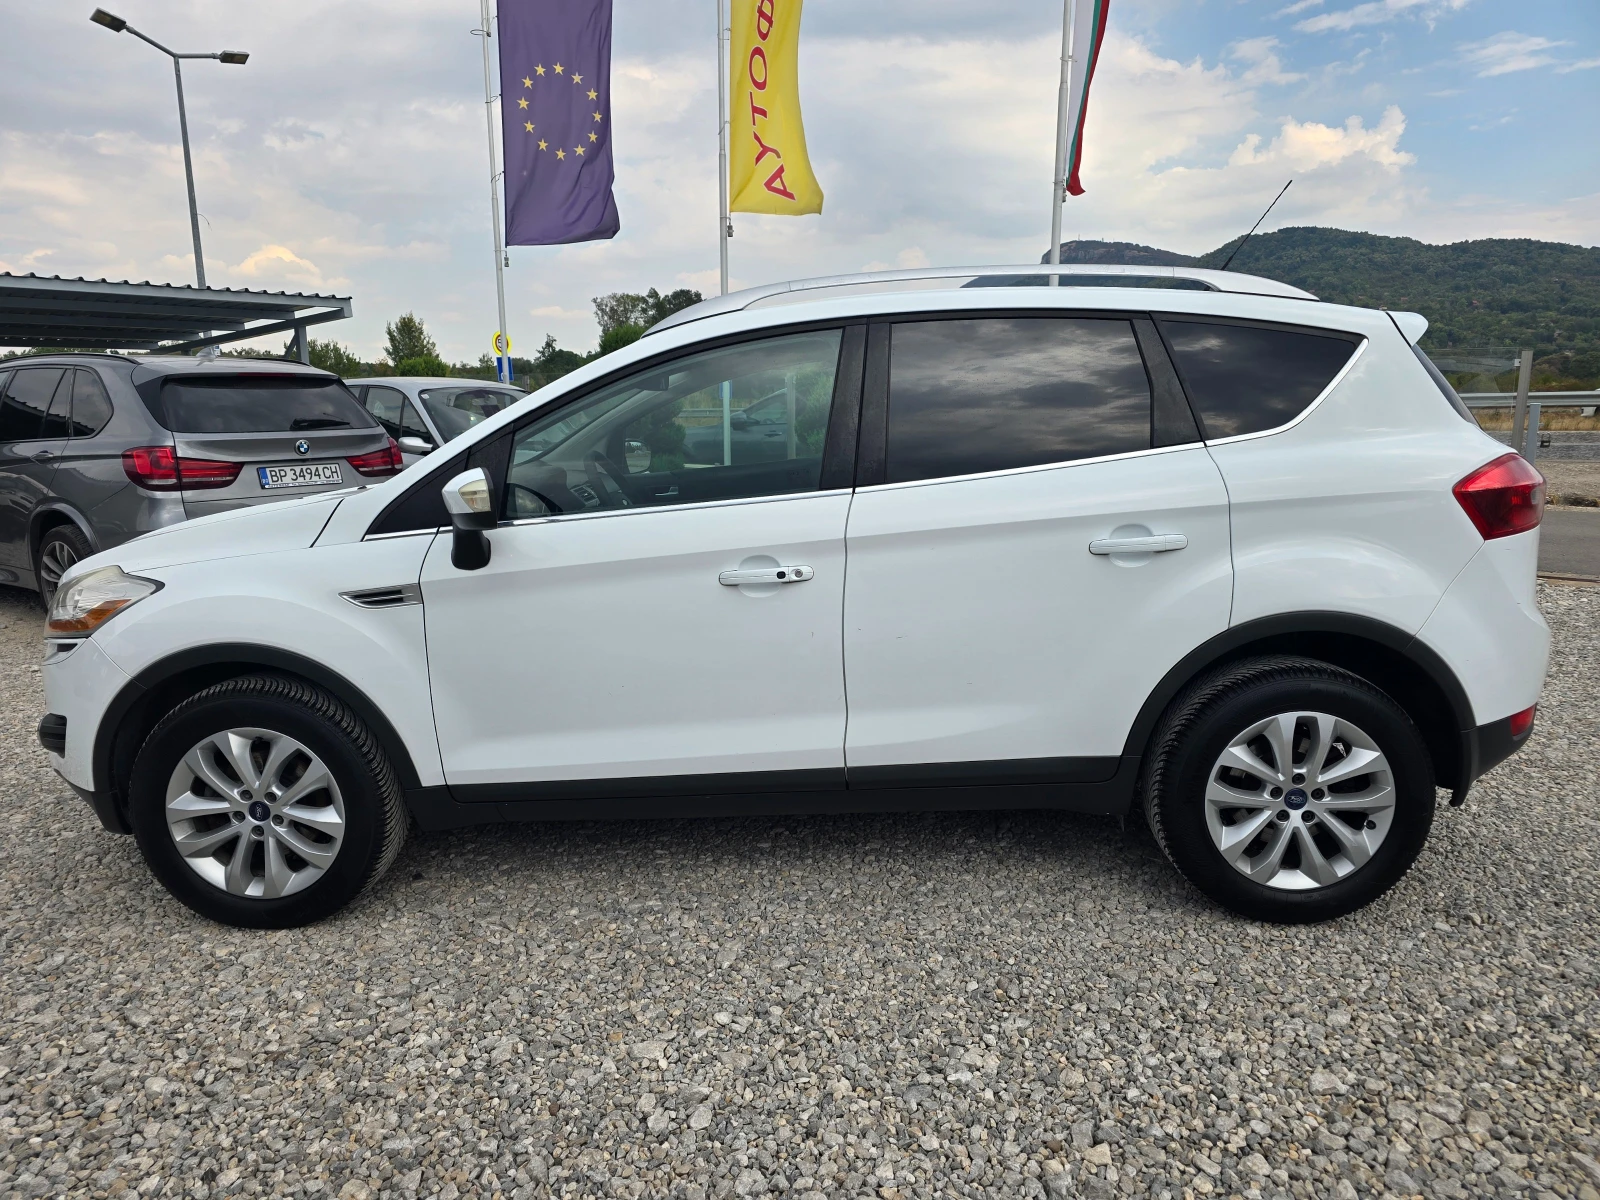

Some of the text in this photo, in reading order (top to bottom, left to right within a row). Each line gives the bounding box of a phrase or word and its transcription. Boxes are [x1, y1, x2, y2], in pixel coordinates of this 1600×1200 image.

[269, 469, 287, 483] BP
[290, 466, 321, 481] 3494
[322, 466, 340, 479] CH
